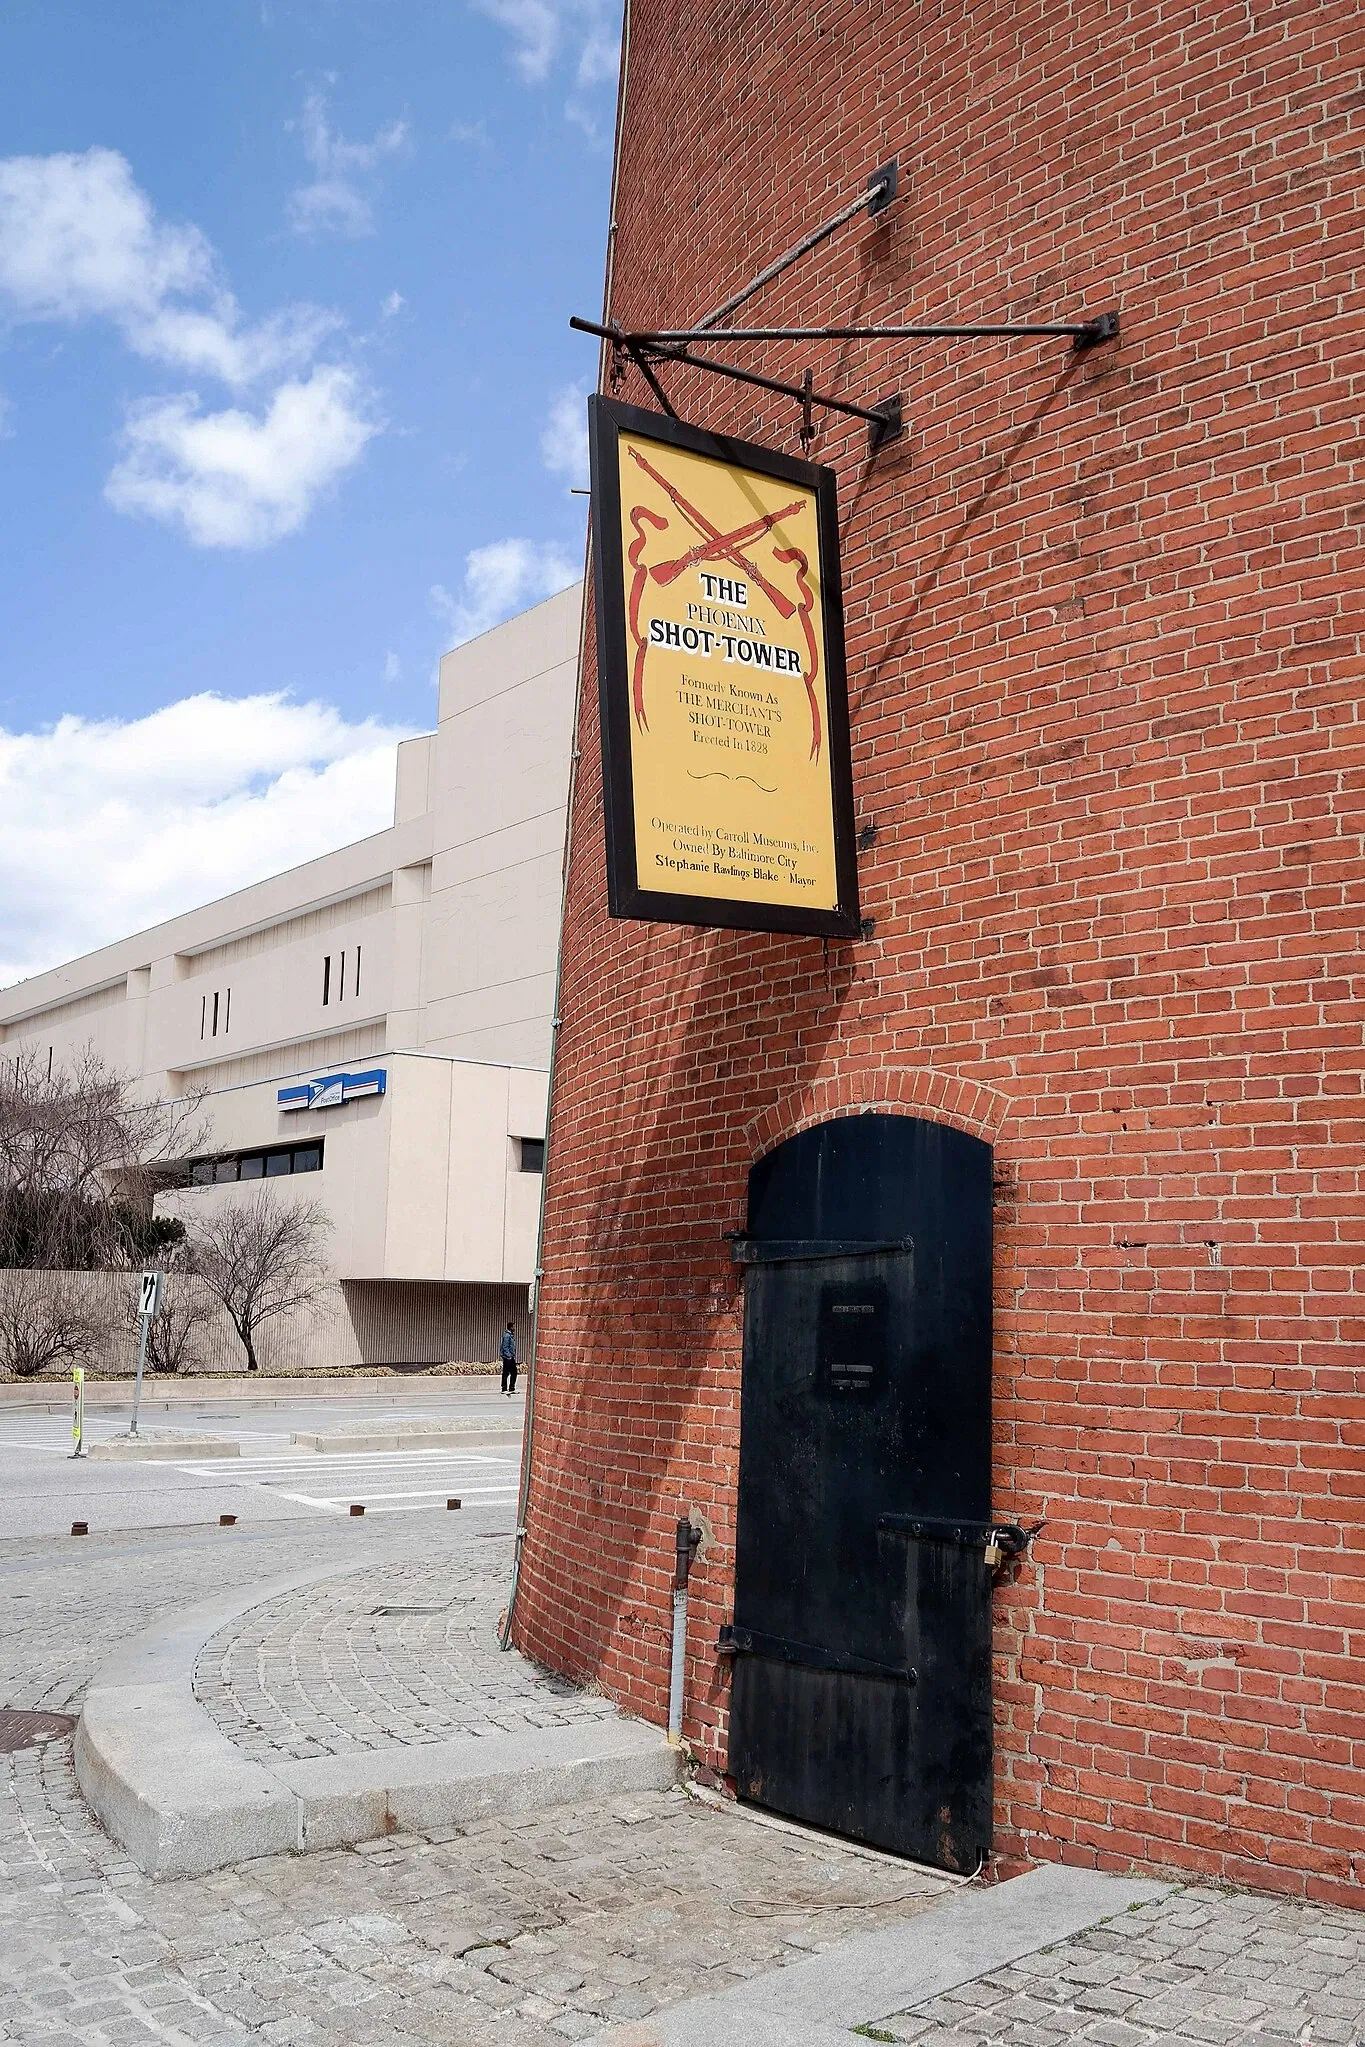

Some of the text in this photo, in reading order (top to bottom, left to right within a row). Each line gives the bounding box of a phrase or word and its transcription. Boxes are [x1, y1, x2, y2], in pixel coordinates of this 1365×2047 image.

[700, 572, 747, 607] THE
[687, 602, 767, 636] PHOENIX
[650, 619, 802, 675] SHOT-TOWER
[676, 691, 703, 707] THE
[681, 674, 779, 705] Formerly Known As
[688, 711, 771, 738] SHOT-TOWER
[693, 730, 768, 755] Erected In 1828
[651, 816, 819, 854] Operated by Carroll Museums, Inc.
[673, 838, 798, 871] Owned By Baltimore City
[655, 854, 710, 872] Stephanie
[790, 872, 817, 889] Mayor
